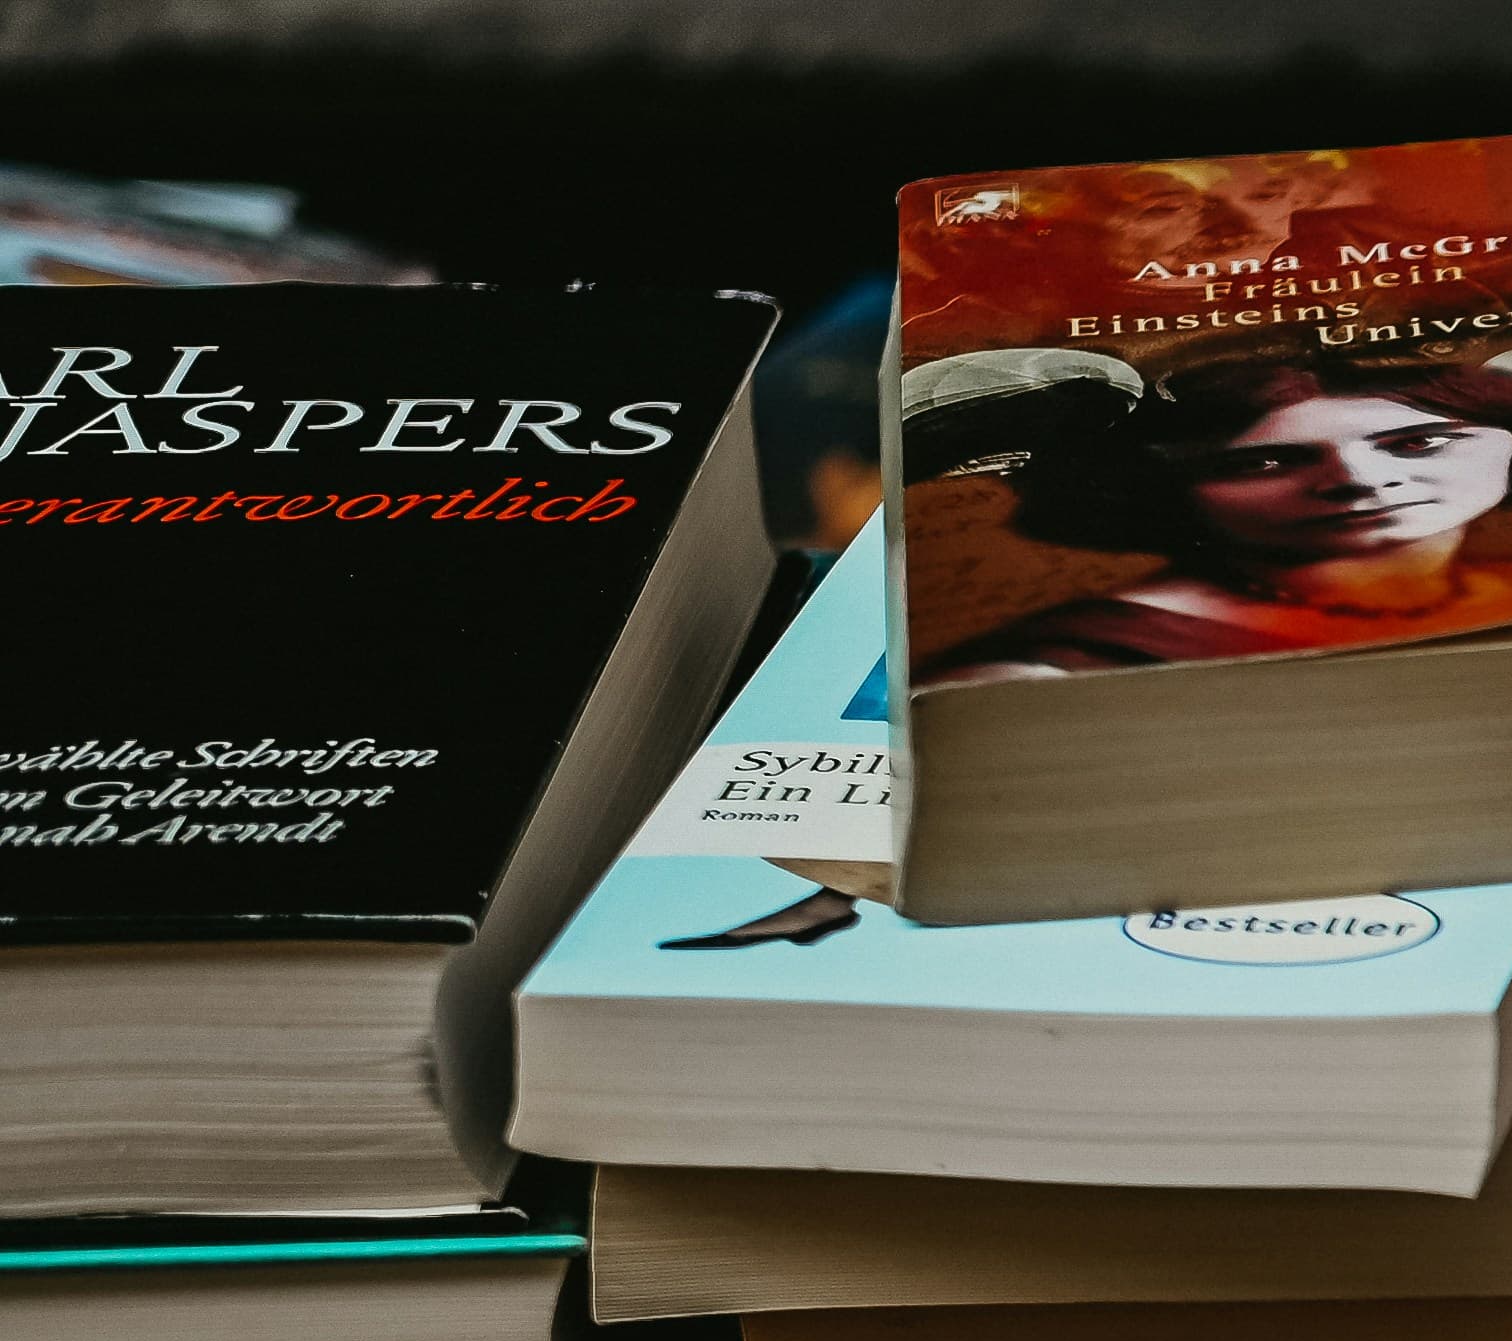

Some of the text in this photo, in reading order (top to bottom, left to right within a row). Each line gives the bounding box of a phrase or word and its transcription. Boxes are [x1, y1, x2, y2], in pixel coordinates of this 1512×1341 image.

[1131, 251, 1302, 284] Anna
[1204, 261, 1468, 303] Fräulein
[1066, 299, 1362, 338] Einsteins
[0, 346, 243, 399] RL
[0, 399, 682, 462] JASPERS
[176, 737, 440, 775] Schriften
[65, 777, 396, 812] Geleitwort
[715, 780, 812, 802] Ein
[117, 811, 347, 847] Arendt
[701, 808, 800, 823] Roman
[1149, 909, 1417, 938] Bestseller
